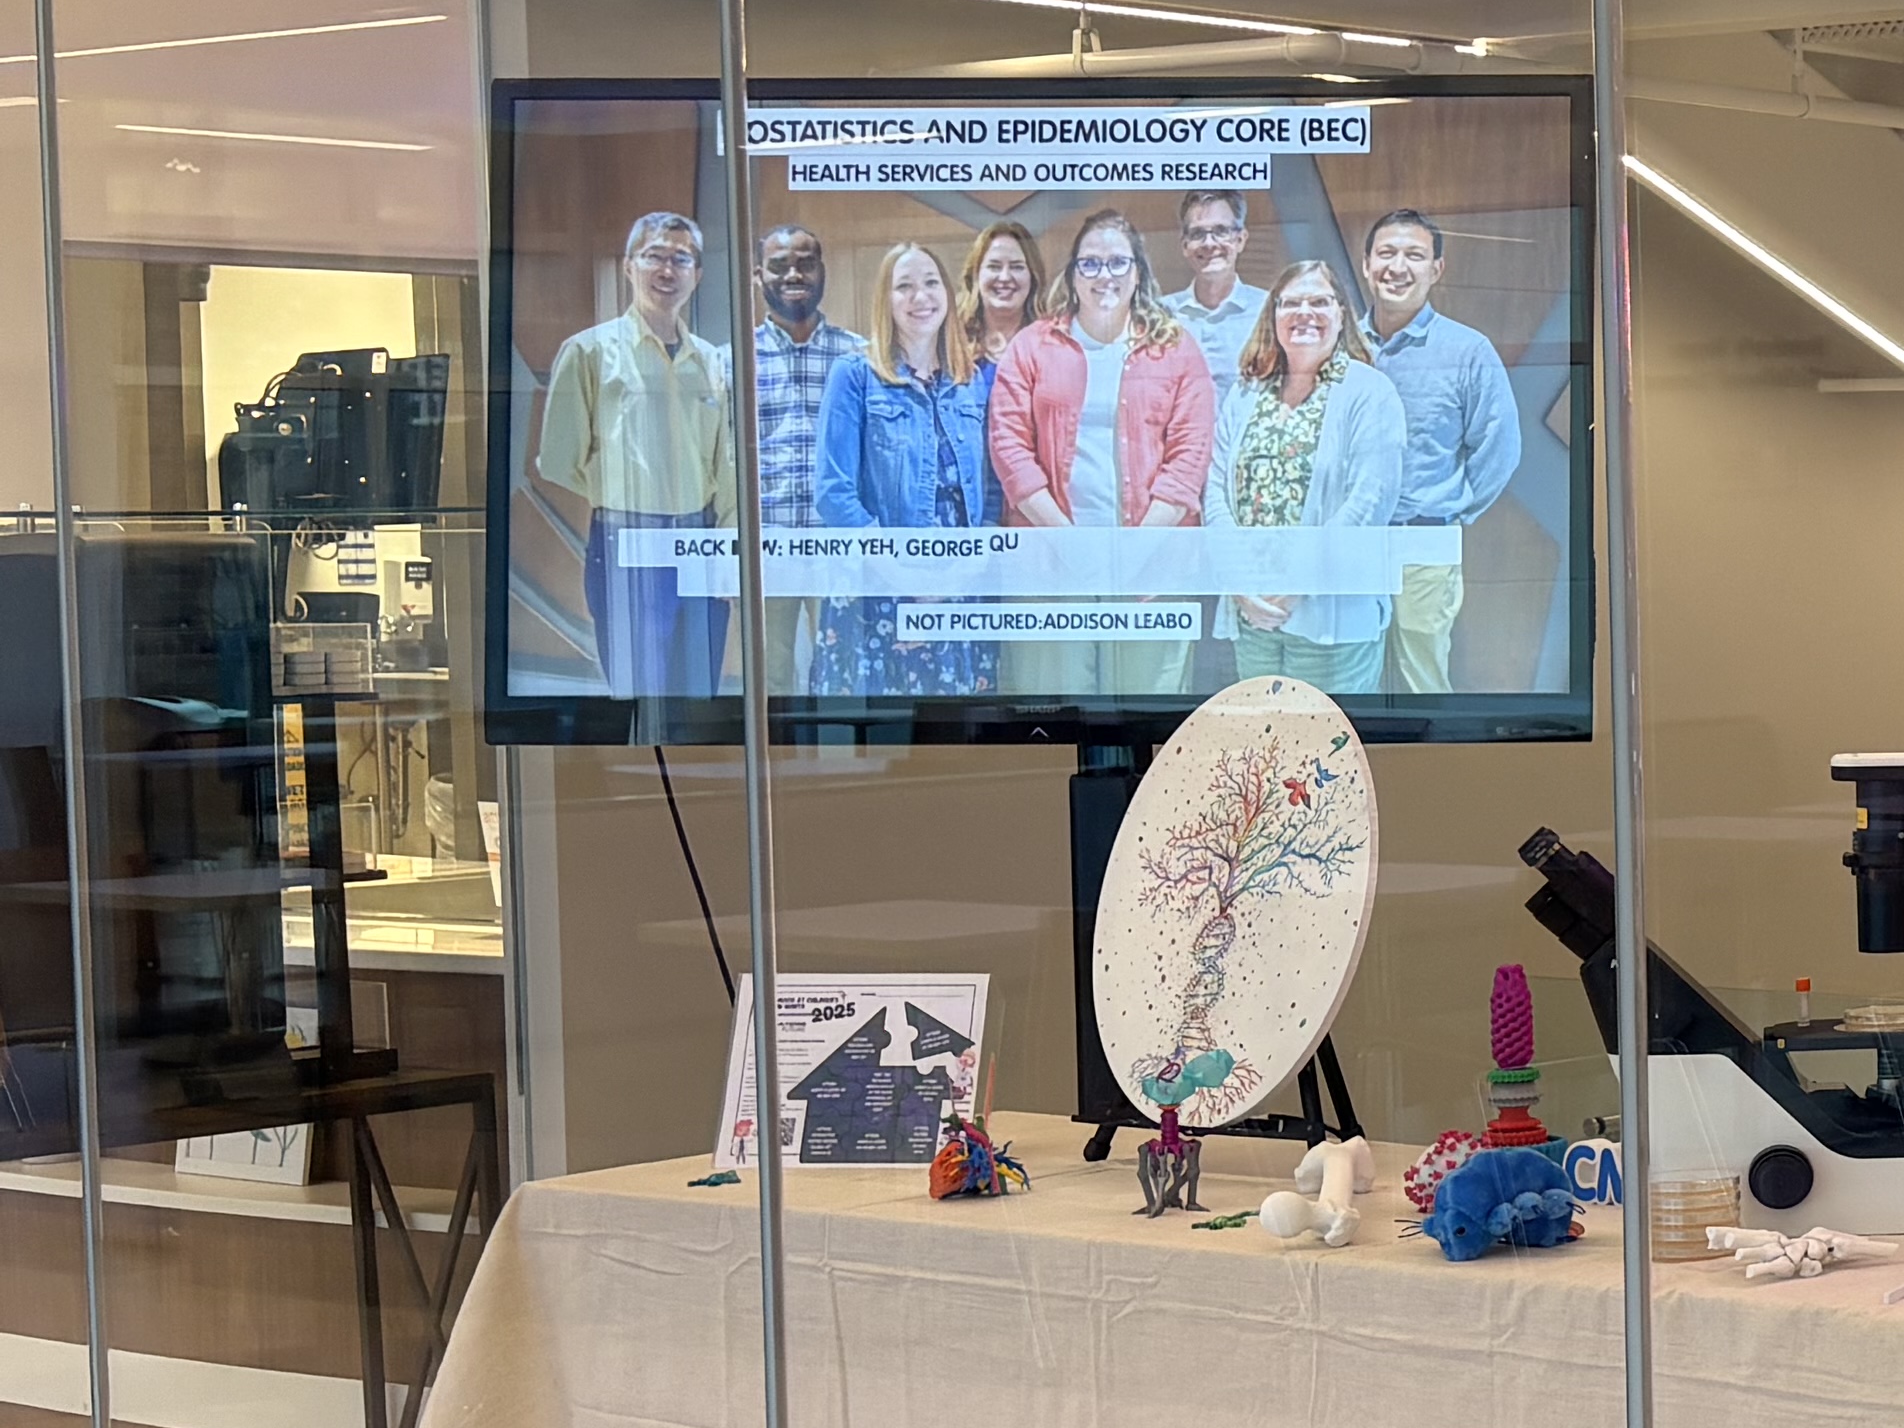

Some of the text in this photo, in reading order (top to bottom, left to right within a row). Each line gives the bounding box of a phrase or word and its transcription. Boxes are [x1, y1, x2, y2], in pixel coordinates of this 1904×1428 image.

[746, 118, 1368, 145] OSTATISTICS AND EPIDEMIOLOGY CORE (BEC)
[791, 163, 1267, 182] HEALTH SERVICES AND OUTCOMES RESEARCH
[674, 534, 1018, 558] BACK HENRY YEH, GEORGE QU
[905, 613, 1192, 631] NOT PICTURED:ADDISON LEABO
[812, 1002, 855, 1023] 2025
